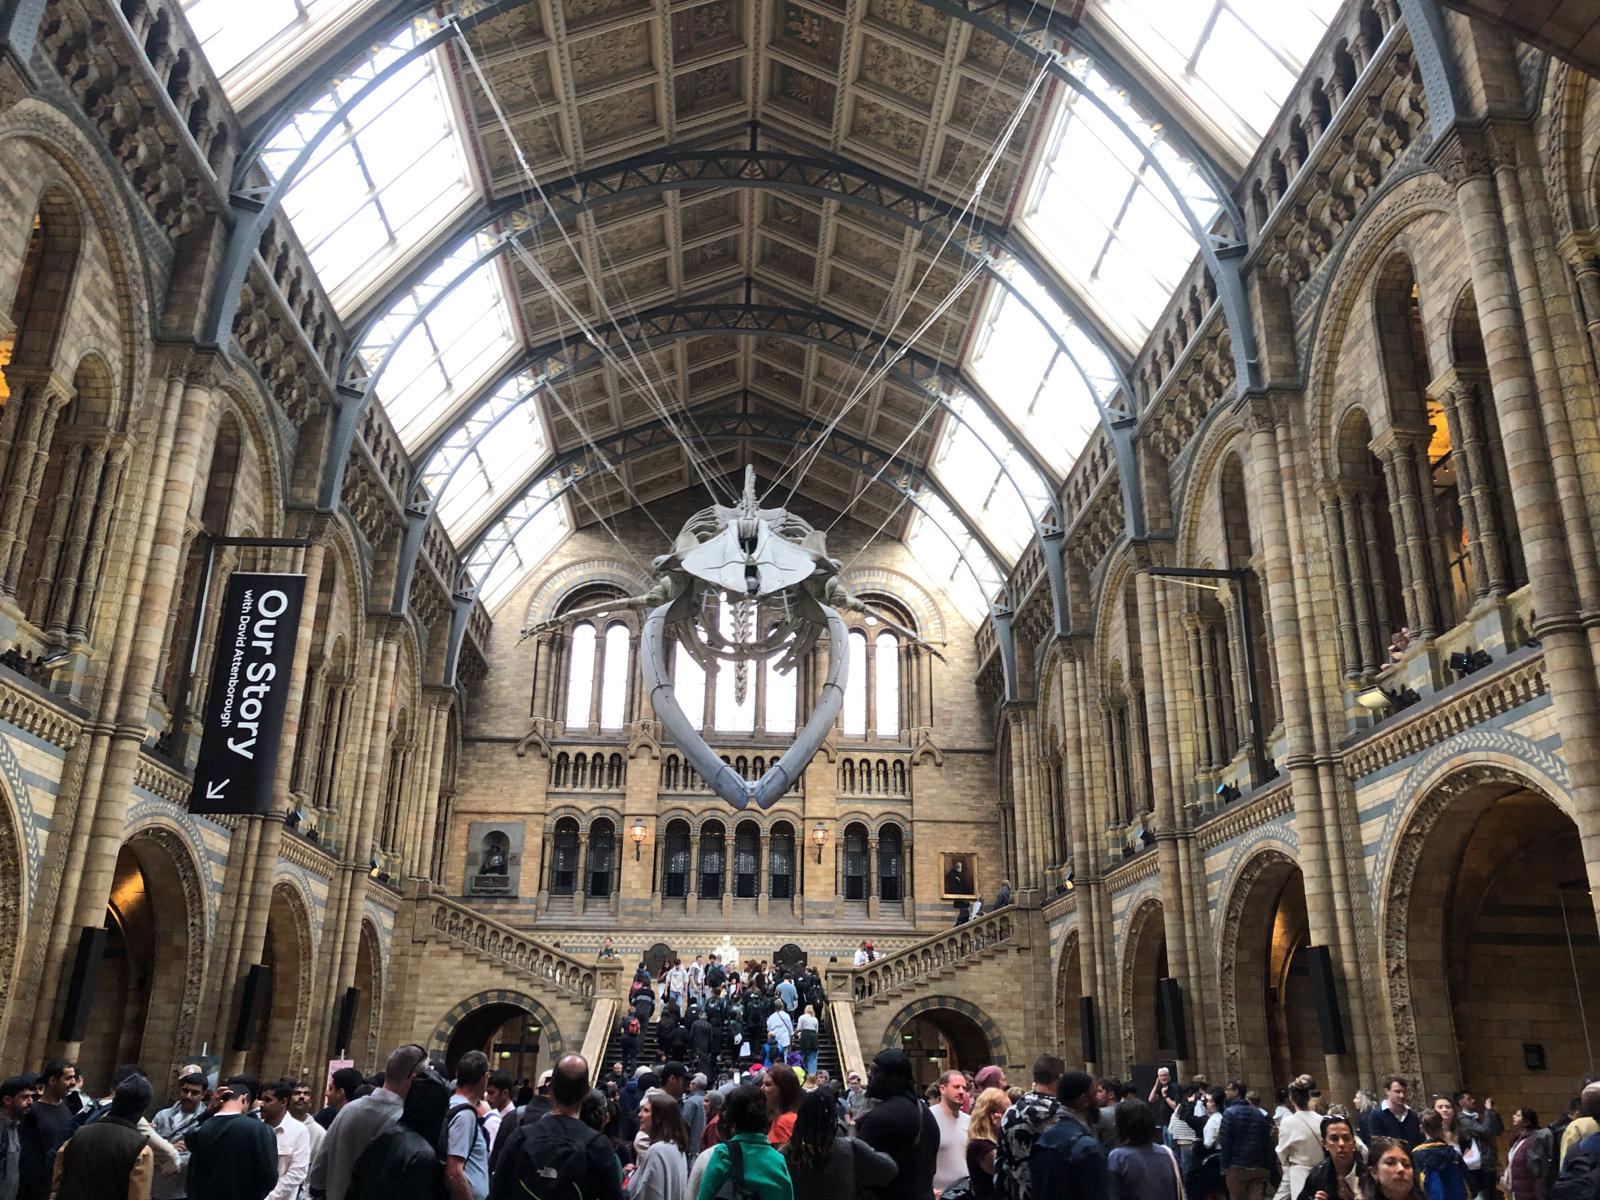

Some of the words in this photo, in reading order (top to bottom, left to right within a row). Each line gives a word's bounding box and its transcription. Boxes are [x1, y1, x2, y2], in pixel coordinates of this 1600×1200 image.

[236, 615, 251, 647] David
[241, 589, 254, 614] with
[251, 589, 289, 656] Our
[220, 648, 245, 728] Attenborough
[227, 662, 277, 760] Story
